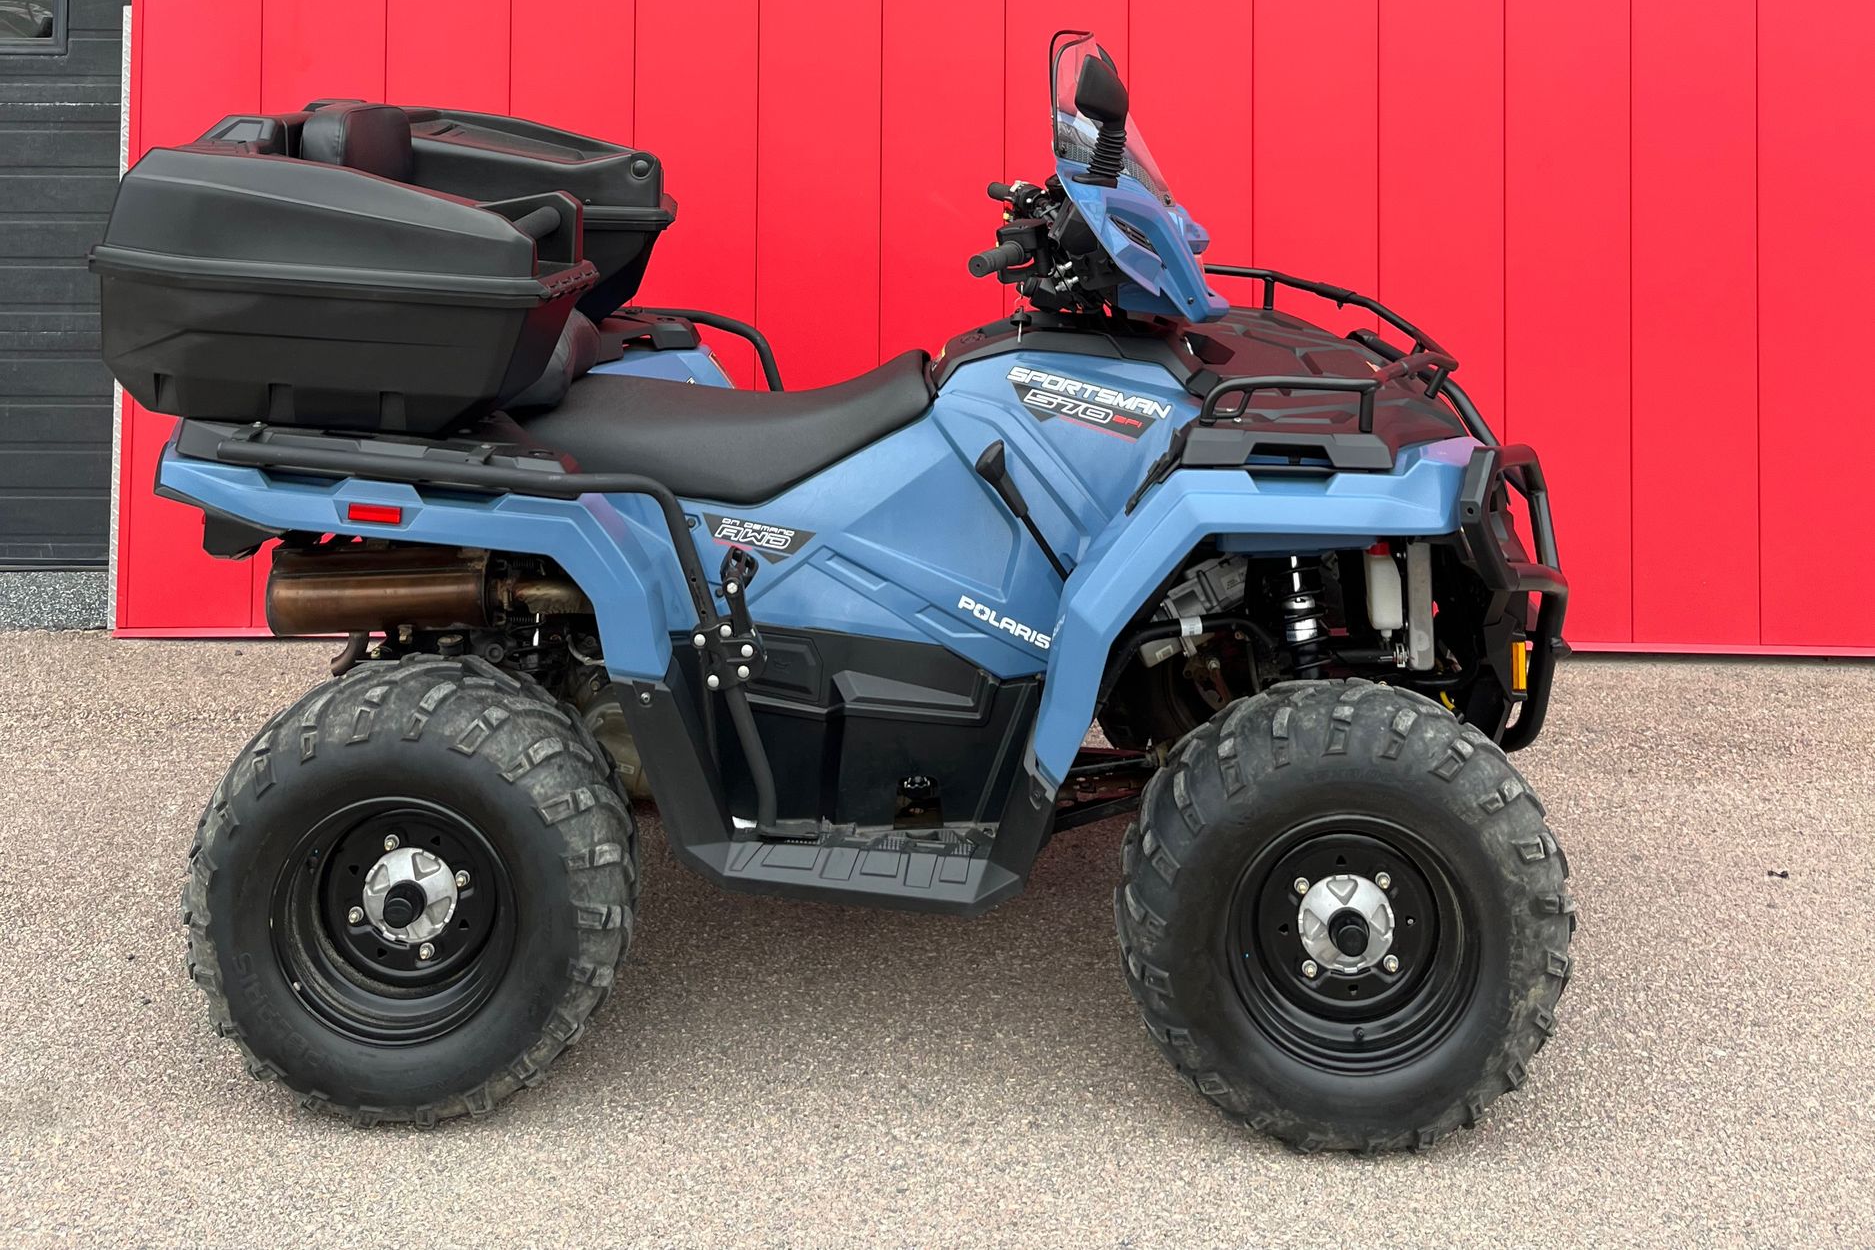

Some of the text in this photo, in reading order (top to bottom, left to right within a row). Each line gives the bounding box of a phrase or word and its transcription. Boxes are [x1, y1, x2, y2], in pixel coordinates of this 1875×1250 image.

[1007, 366, 1172, 419] SPORTSMAN
[1023, 388, 1114, 424] 570
[714, 524, 792, 550] AWD
[722, 517, 795, 536] ON DEMAND
[957, 595, 1052, 650] POLARIS
